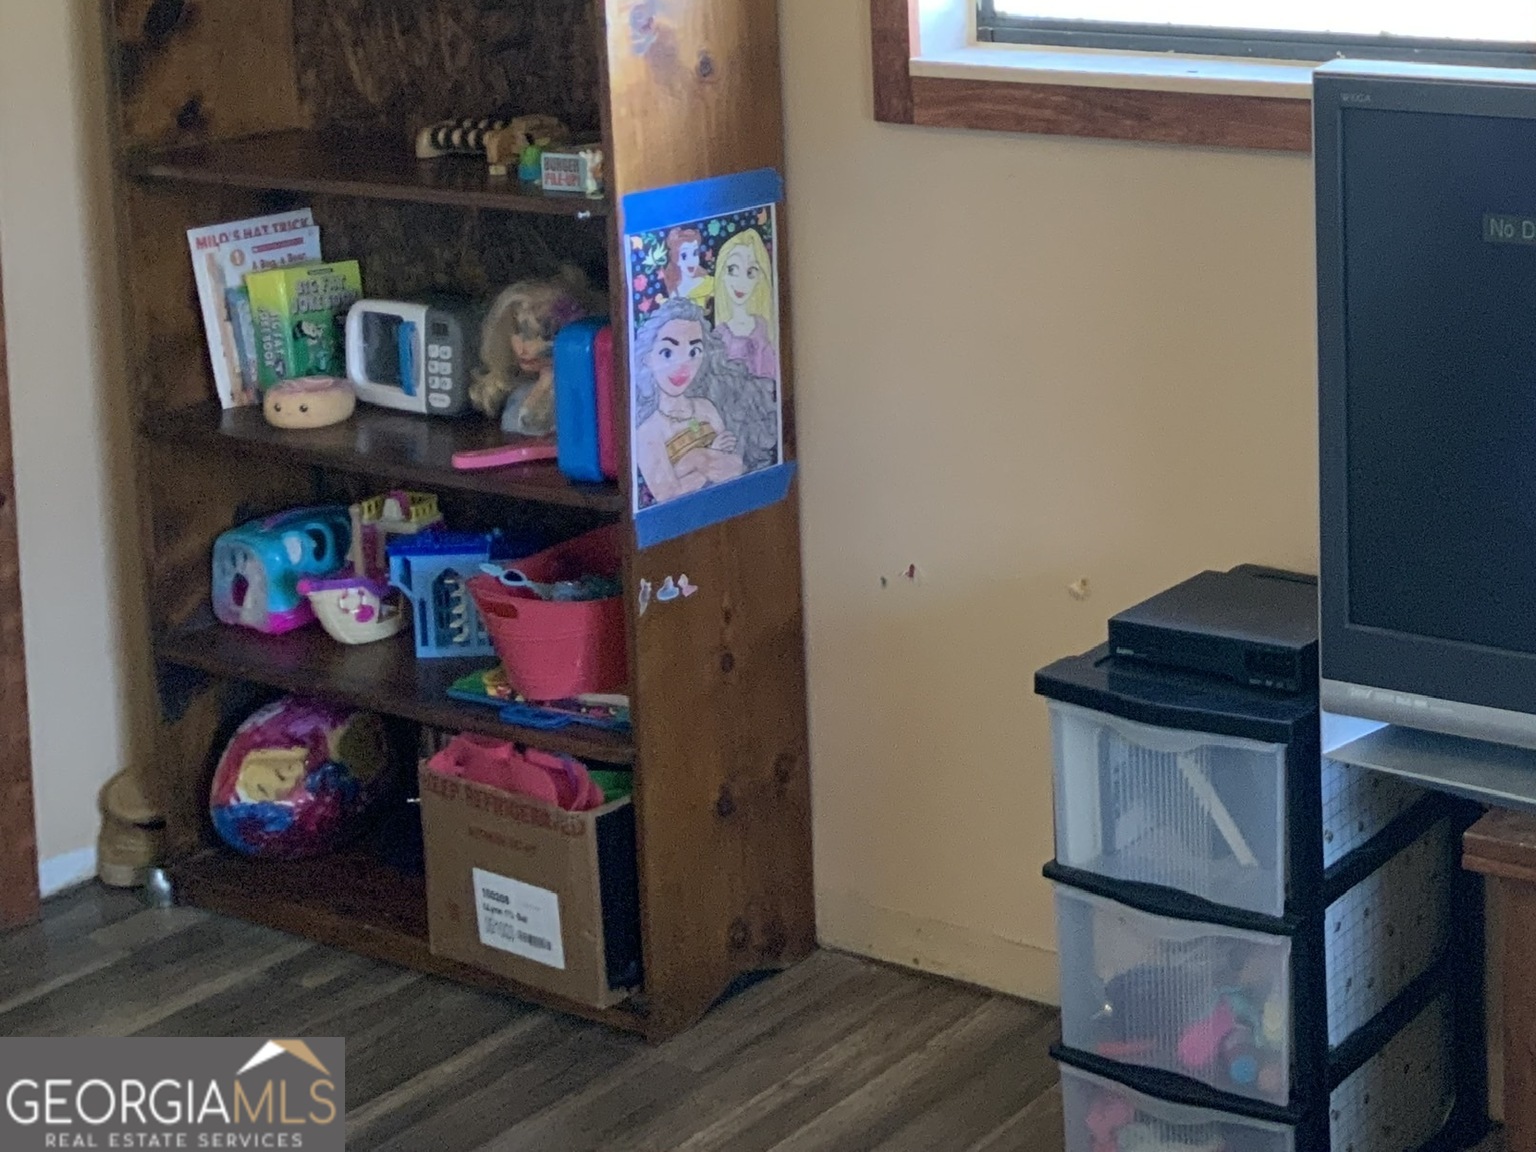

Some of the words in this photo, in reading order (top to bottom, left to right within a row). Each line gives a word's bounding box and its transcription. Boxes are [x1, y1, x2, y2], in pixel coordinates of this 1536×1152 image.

[195, 229, 241, 250] MILO'S
[243, 224, 269, 240] HAT
[272, 216, 310, 234] TRICK
[1489, 217, 1515, 238] No
